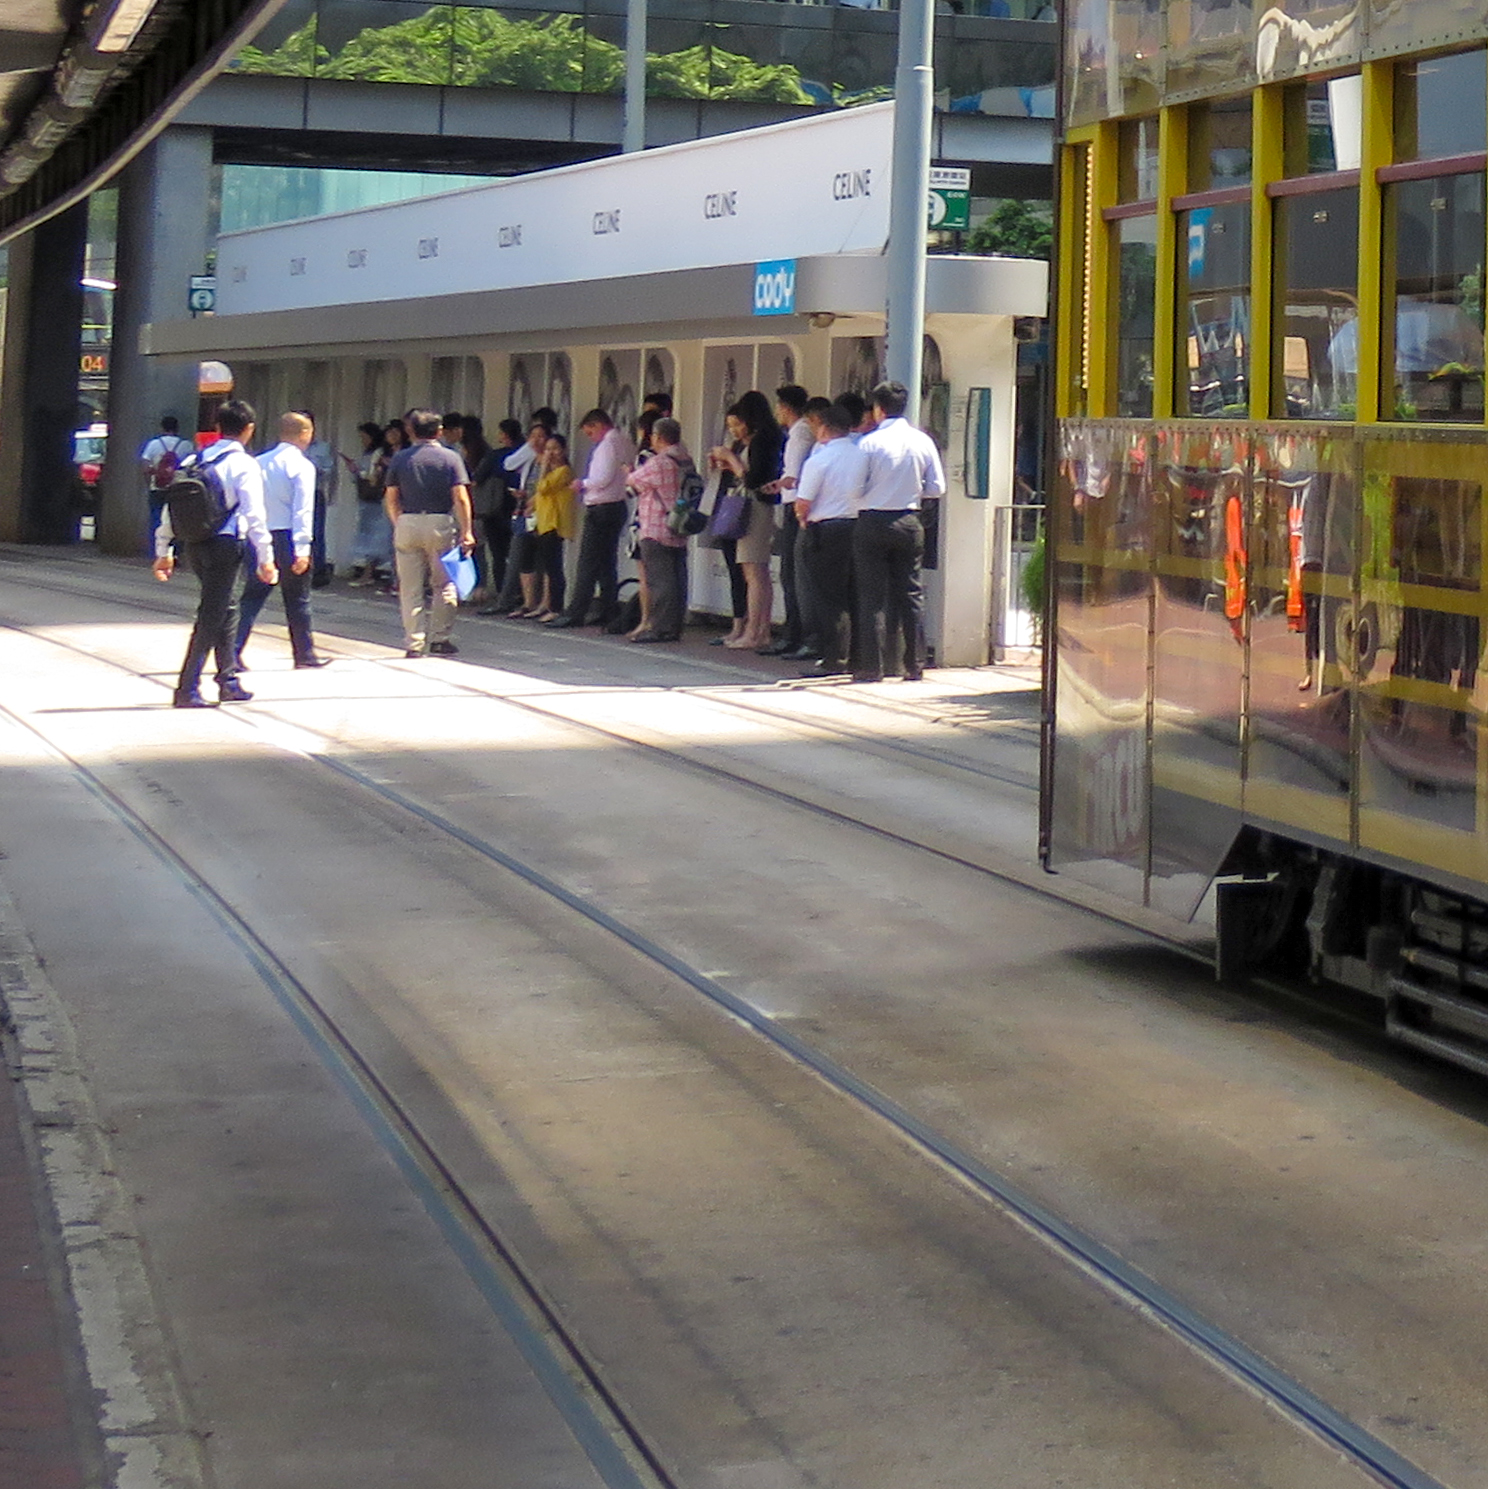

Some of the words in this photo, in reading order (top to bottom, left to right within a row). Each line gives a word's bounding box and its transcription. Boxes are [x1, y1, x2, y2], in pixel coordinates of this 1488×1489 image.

[833, 169, 871, 201] CELINE
[704, 190, 738, 220] CELINE
[592, 208, 622, 235] CELINE
